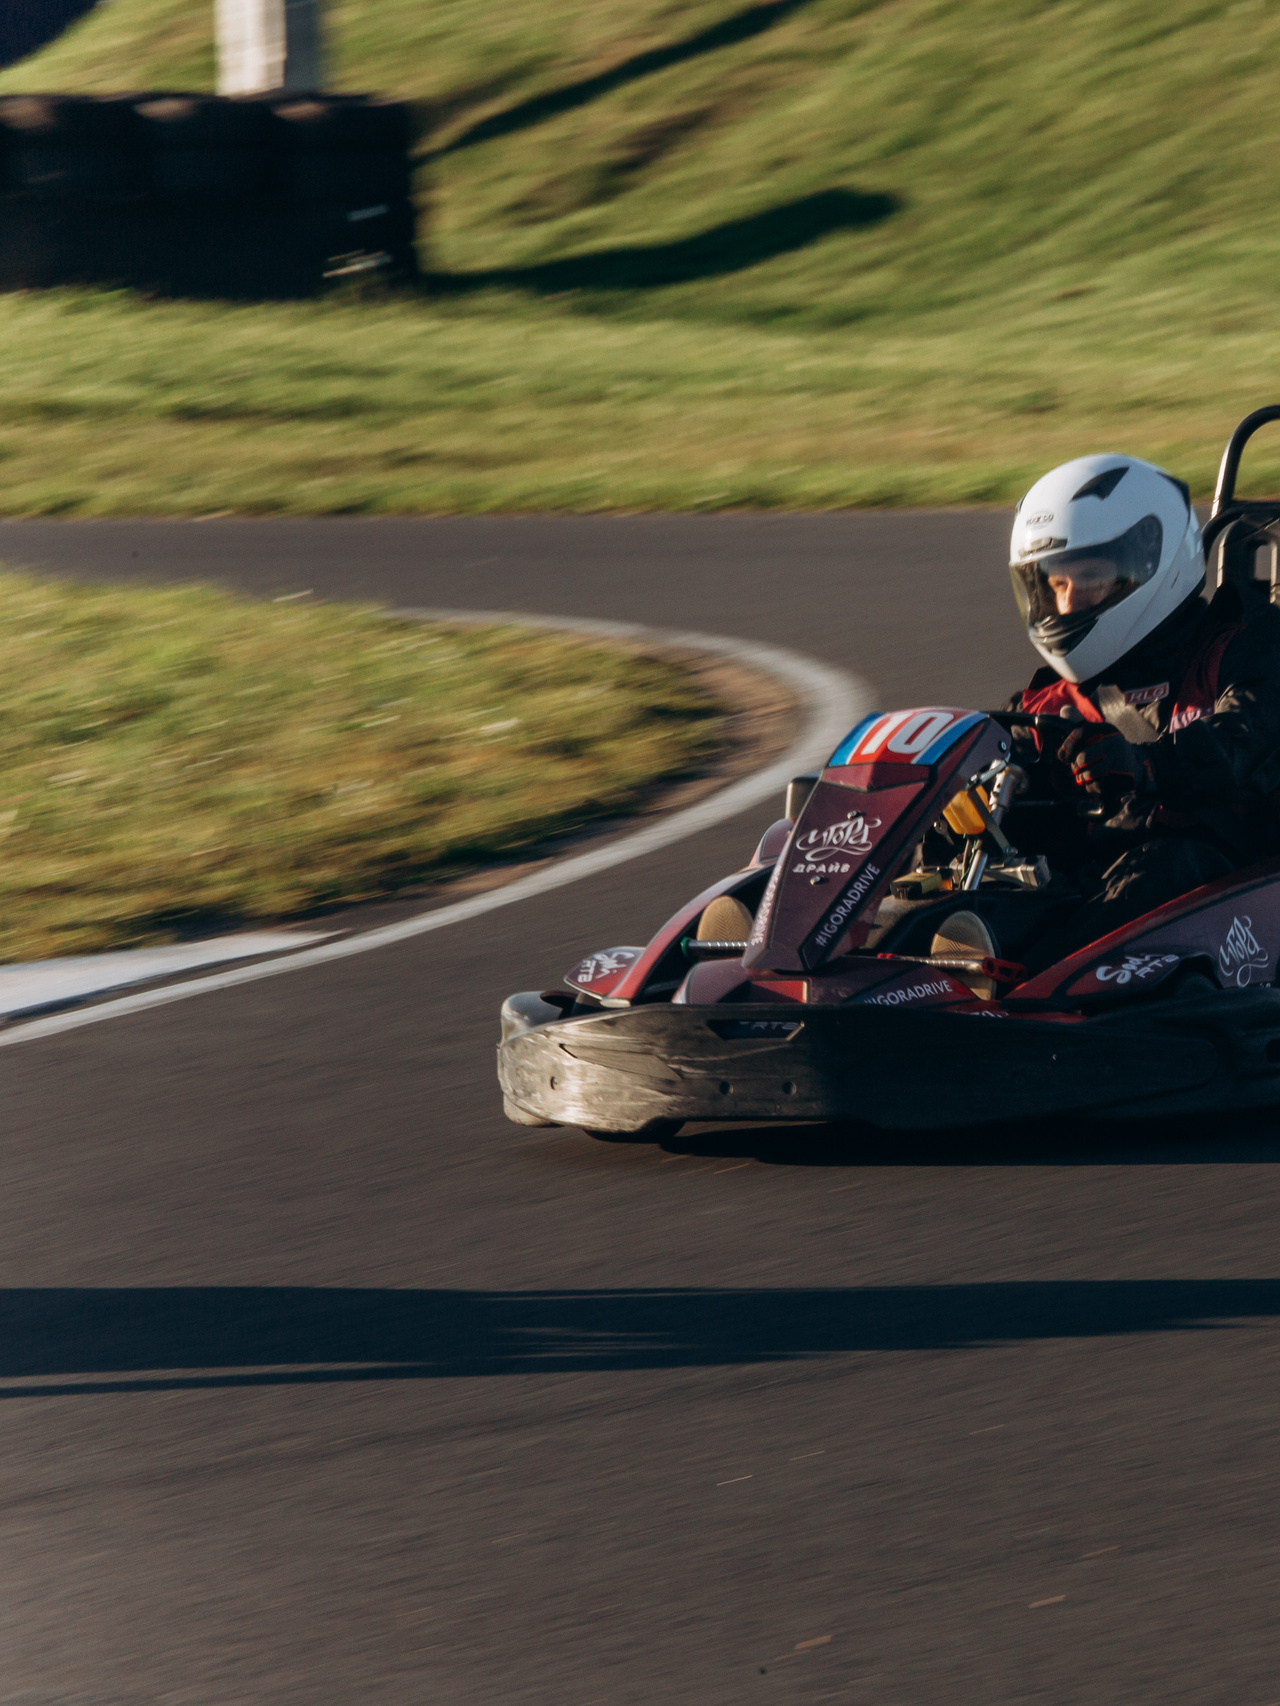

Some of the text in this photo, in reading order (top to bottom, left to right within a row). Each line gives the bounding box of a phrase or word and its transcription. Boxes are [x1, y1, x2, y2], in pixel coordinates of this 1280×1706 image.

[861, 711, 954, 754] 10
[793, 862, 850, 873] ДРАЙВ
[815, 863, 880, 946] #IGORADRIVE
